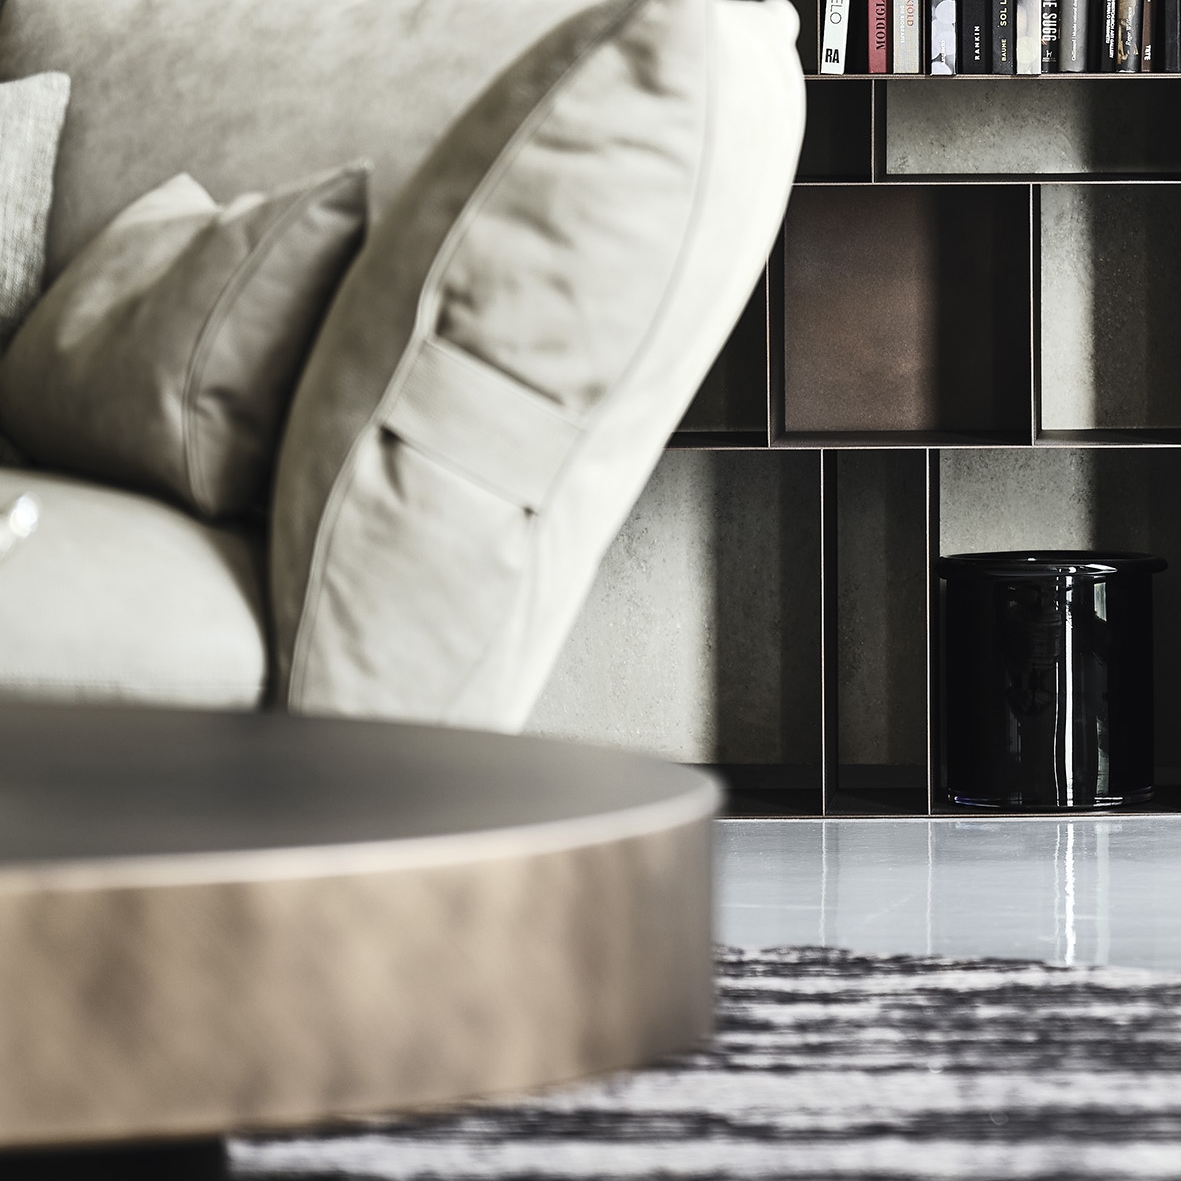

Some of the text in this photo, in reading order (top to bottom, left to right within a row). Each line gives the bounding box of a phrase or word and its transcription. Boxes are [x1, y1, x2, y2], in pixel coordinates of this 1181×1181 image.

[999, 7, 1007, 26] SOL
[1042, 13, 1057, 42] SUGG
[825, 49, 840, 63] RA
